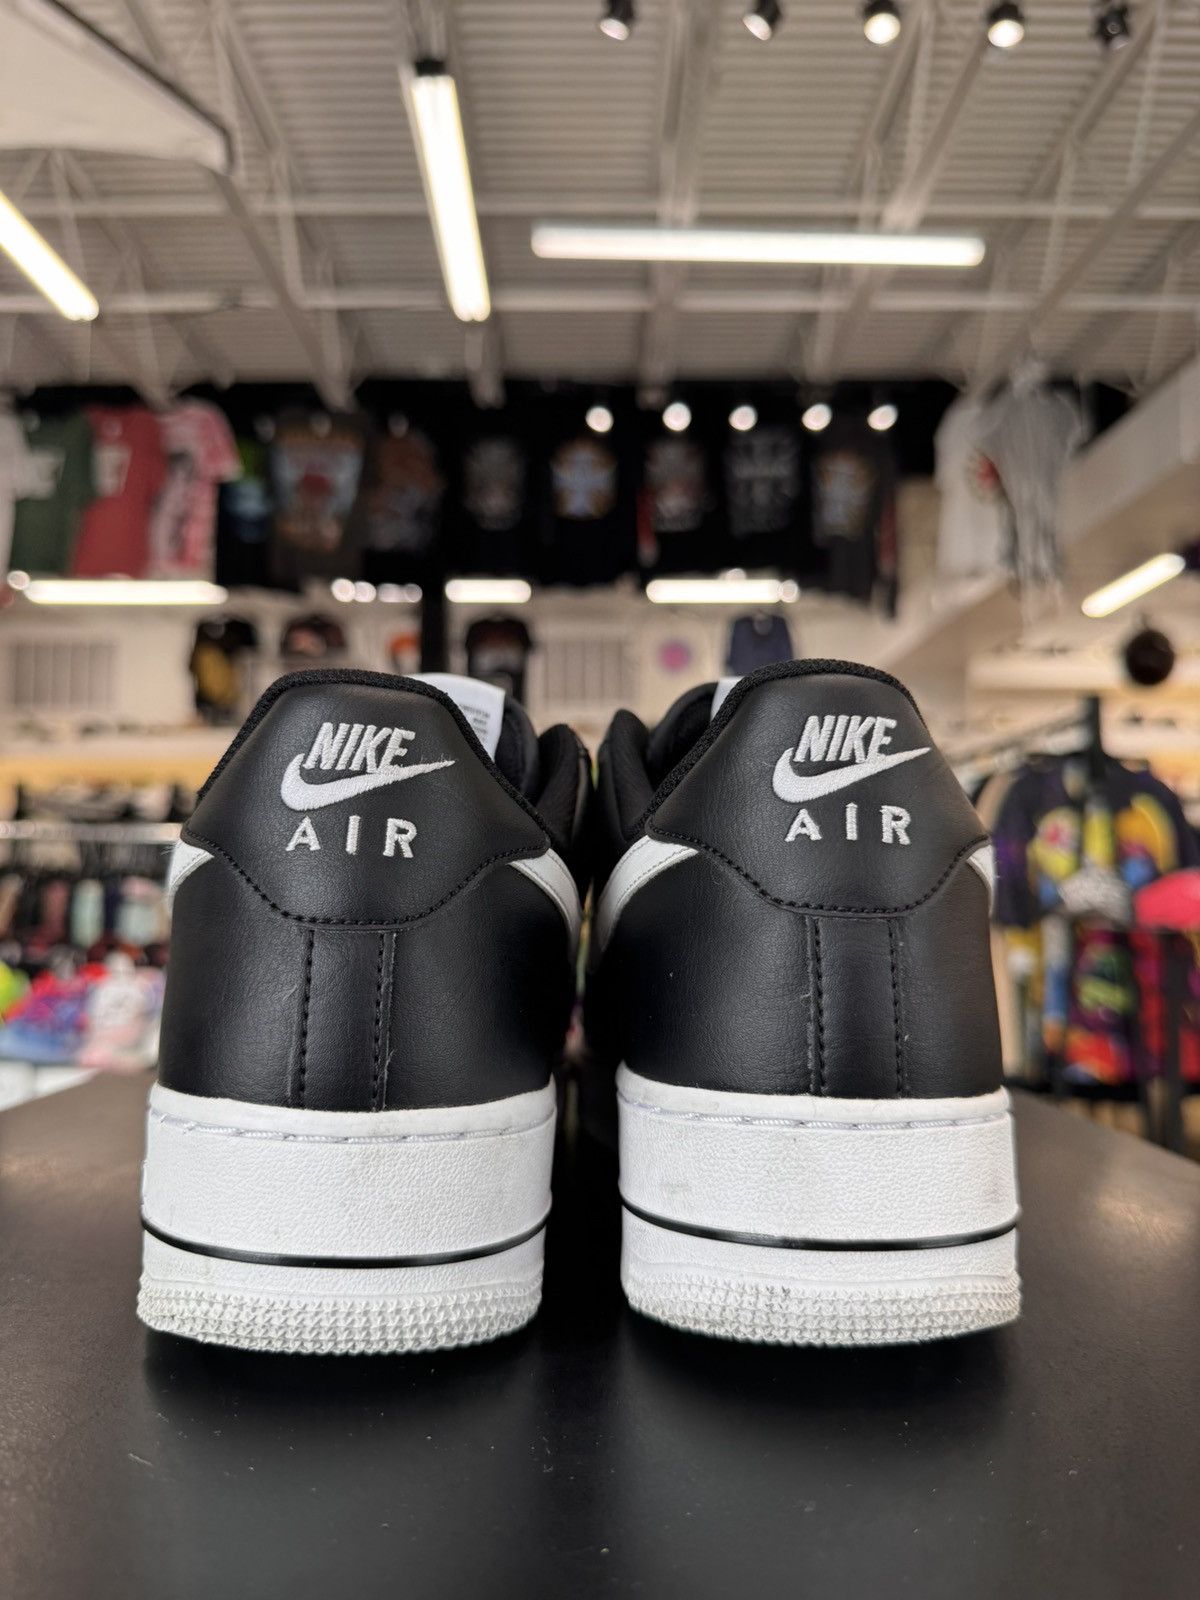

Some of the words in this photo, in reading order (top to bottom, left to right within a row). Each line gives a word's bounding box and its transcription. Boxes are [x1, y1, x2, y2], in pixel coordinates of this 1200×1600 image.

[302, 721, 416, 773] NIKE
[792, 714, 898, 764] NIKE
[285, 814, 418, 858] AIR
[784, 801, 912, 846] AIR
